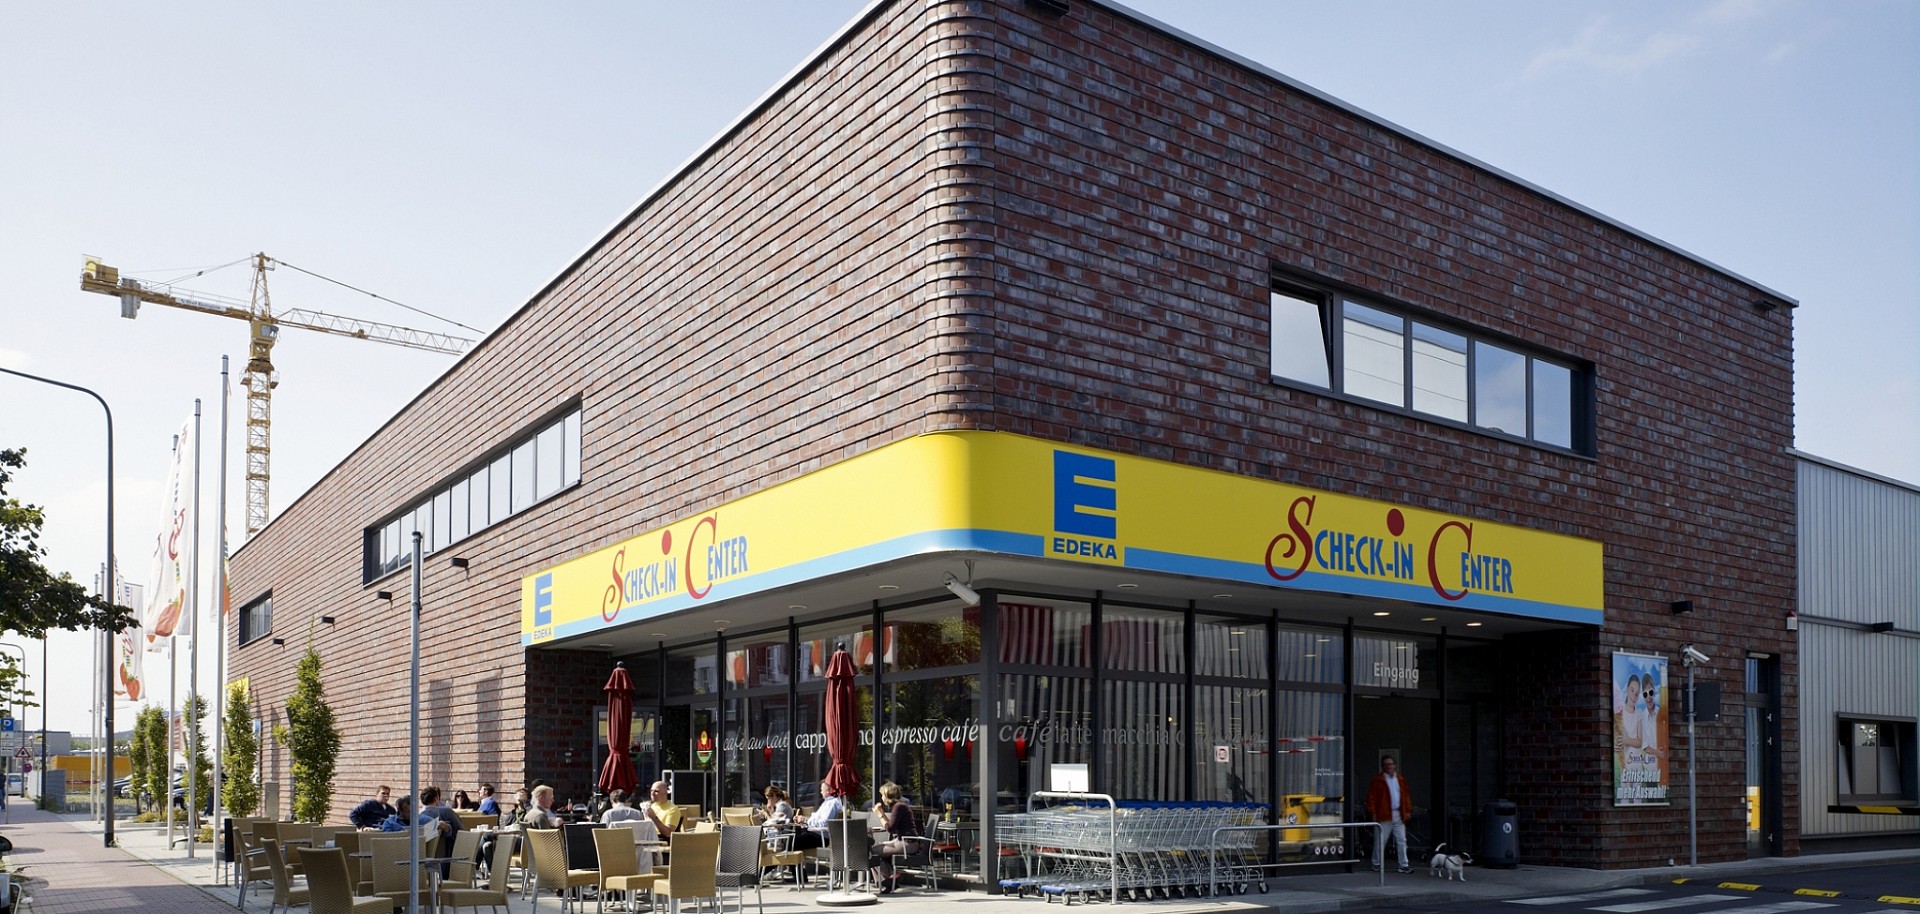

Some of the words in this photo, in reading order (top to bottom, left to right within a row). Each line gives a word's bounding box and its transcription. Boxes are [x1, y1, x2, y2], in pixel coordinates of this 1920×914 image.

[1053, 449, 1116, 539] E
[1053, 537, 1117, 560] EDEKA
[1265, 495, 1414, 581] SCHECK-IN
[1428, 520, 1514, 601] CENTER
[602, 530, 677, 623] SCHECK-IN
[685, 511, 749, 600] CENTER
[535, 572, 552, 627] E
[534, 627, 552, 640] EDEKA
[1374, 662, 1419, 683] Eingang
[881, 725, 938, 753] espresso
[941, 718, 979, 747] café
[998, 720, 1053, 747] café
[1055, 720, 1092, 744] latte
[1102, 723, 1186, 746] macchiao
